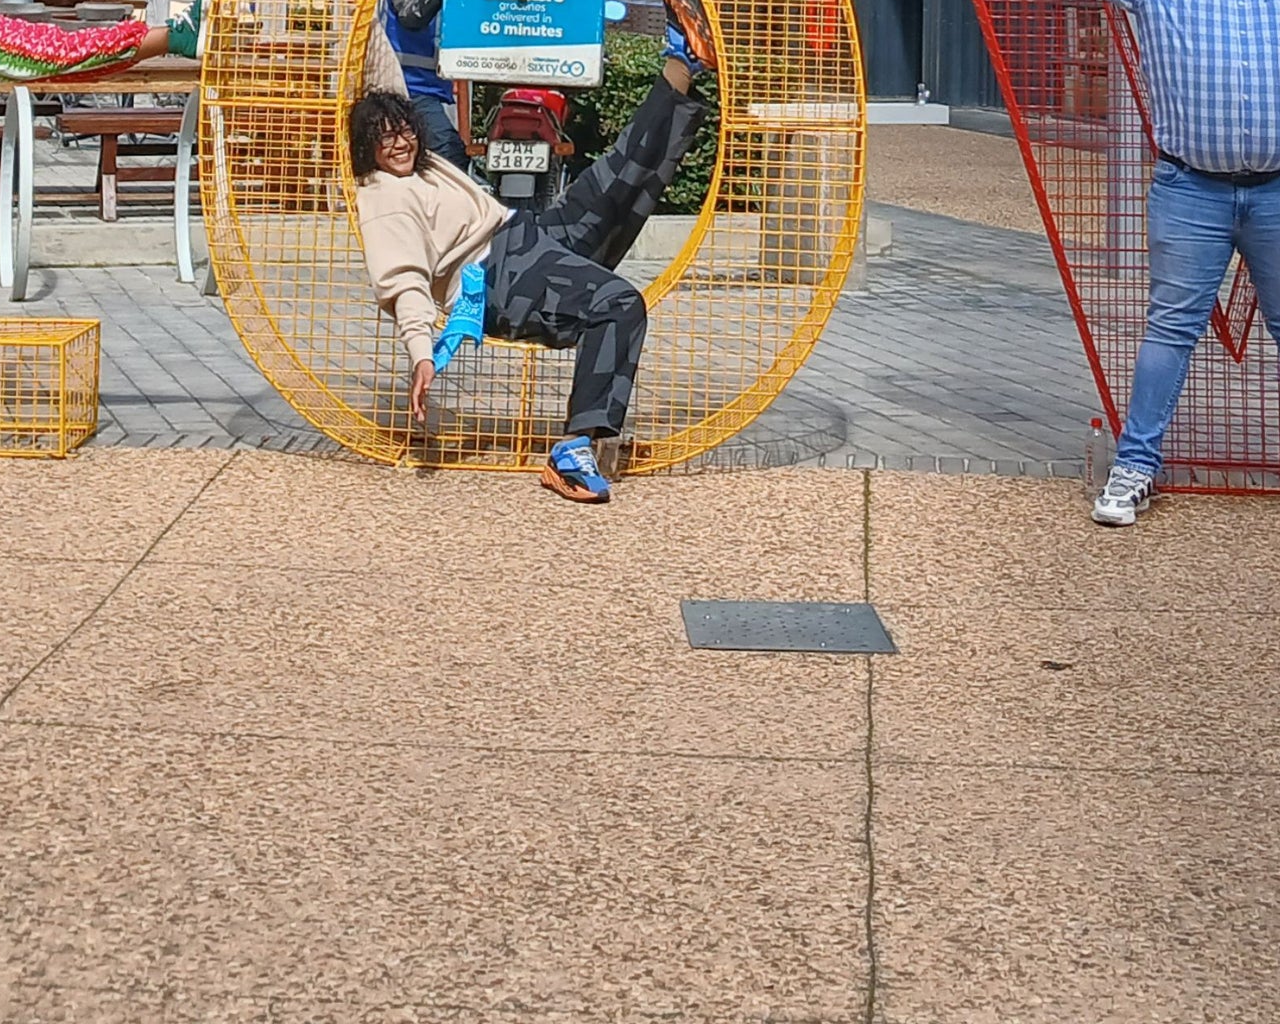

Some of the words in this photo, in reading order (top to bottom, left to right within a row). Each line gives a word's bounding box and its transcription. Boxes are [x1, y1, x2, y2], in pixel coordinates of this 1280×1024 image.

[492, 12, 540, 23] delivered
[542, 13, 553, 24] in
[480, 21, 501, 34] 60
[504, 23, 563, 37] minutes
[501, 142, 533, 154] CAA
[491, 155, 545, 169] 31872
